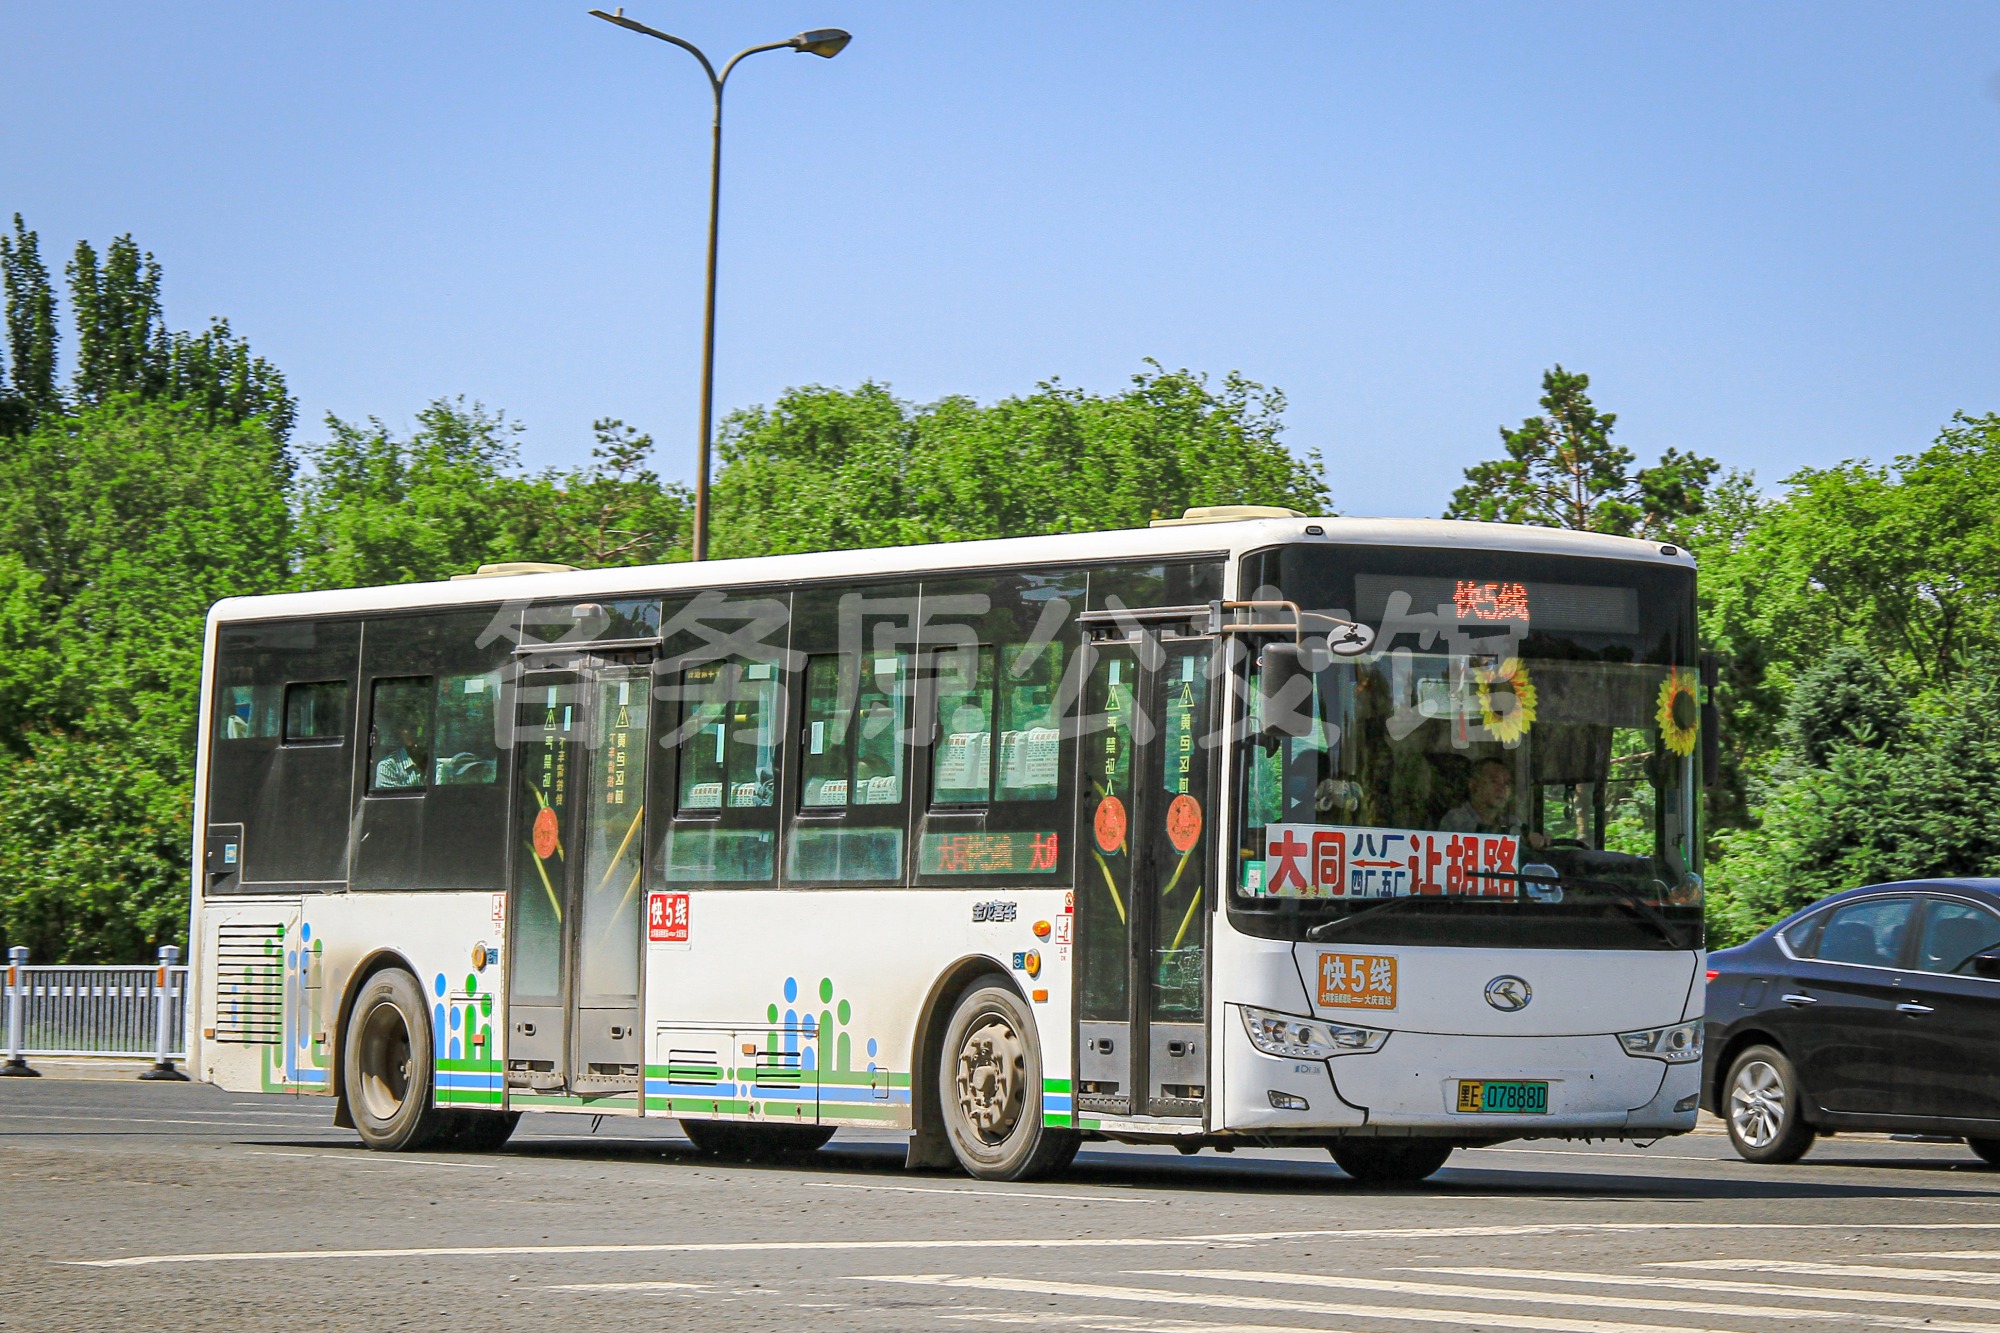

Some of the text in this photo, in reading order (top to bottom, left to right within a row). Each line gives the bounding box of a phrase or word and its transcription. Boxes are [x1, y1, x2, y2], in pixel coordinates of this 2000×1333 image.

[1453, 580, 1530, 621] 快5线
[1352, 833, 1405, 858] 八厂
[651, 897, 687, 927] 快5线
[972, 899, 1018, 922] 金龙客车
[1322, 955, 1393, 993] 快5线
